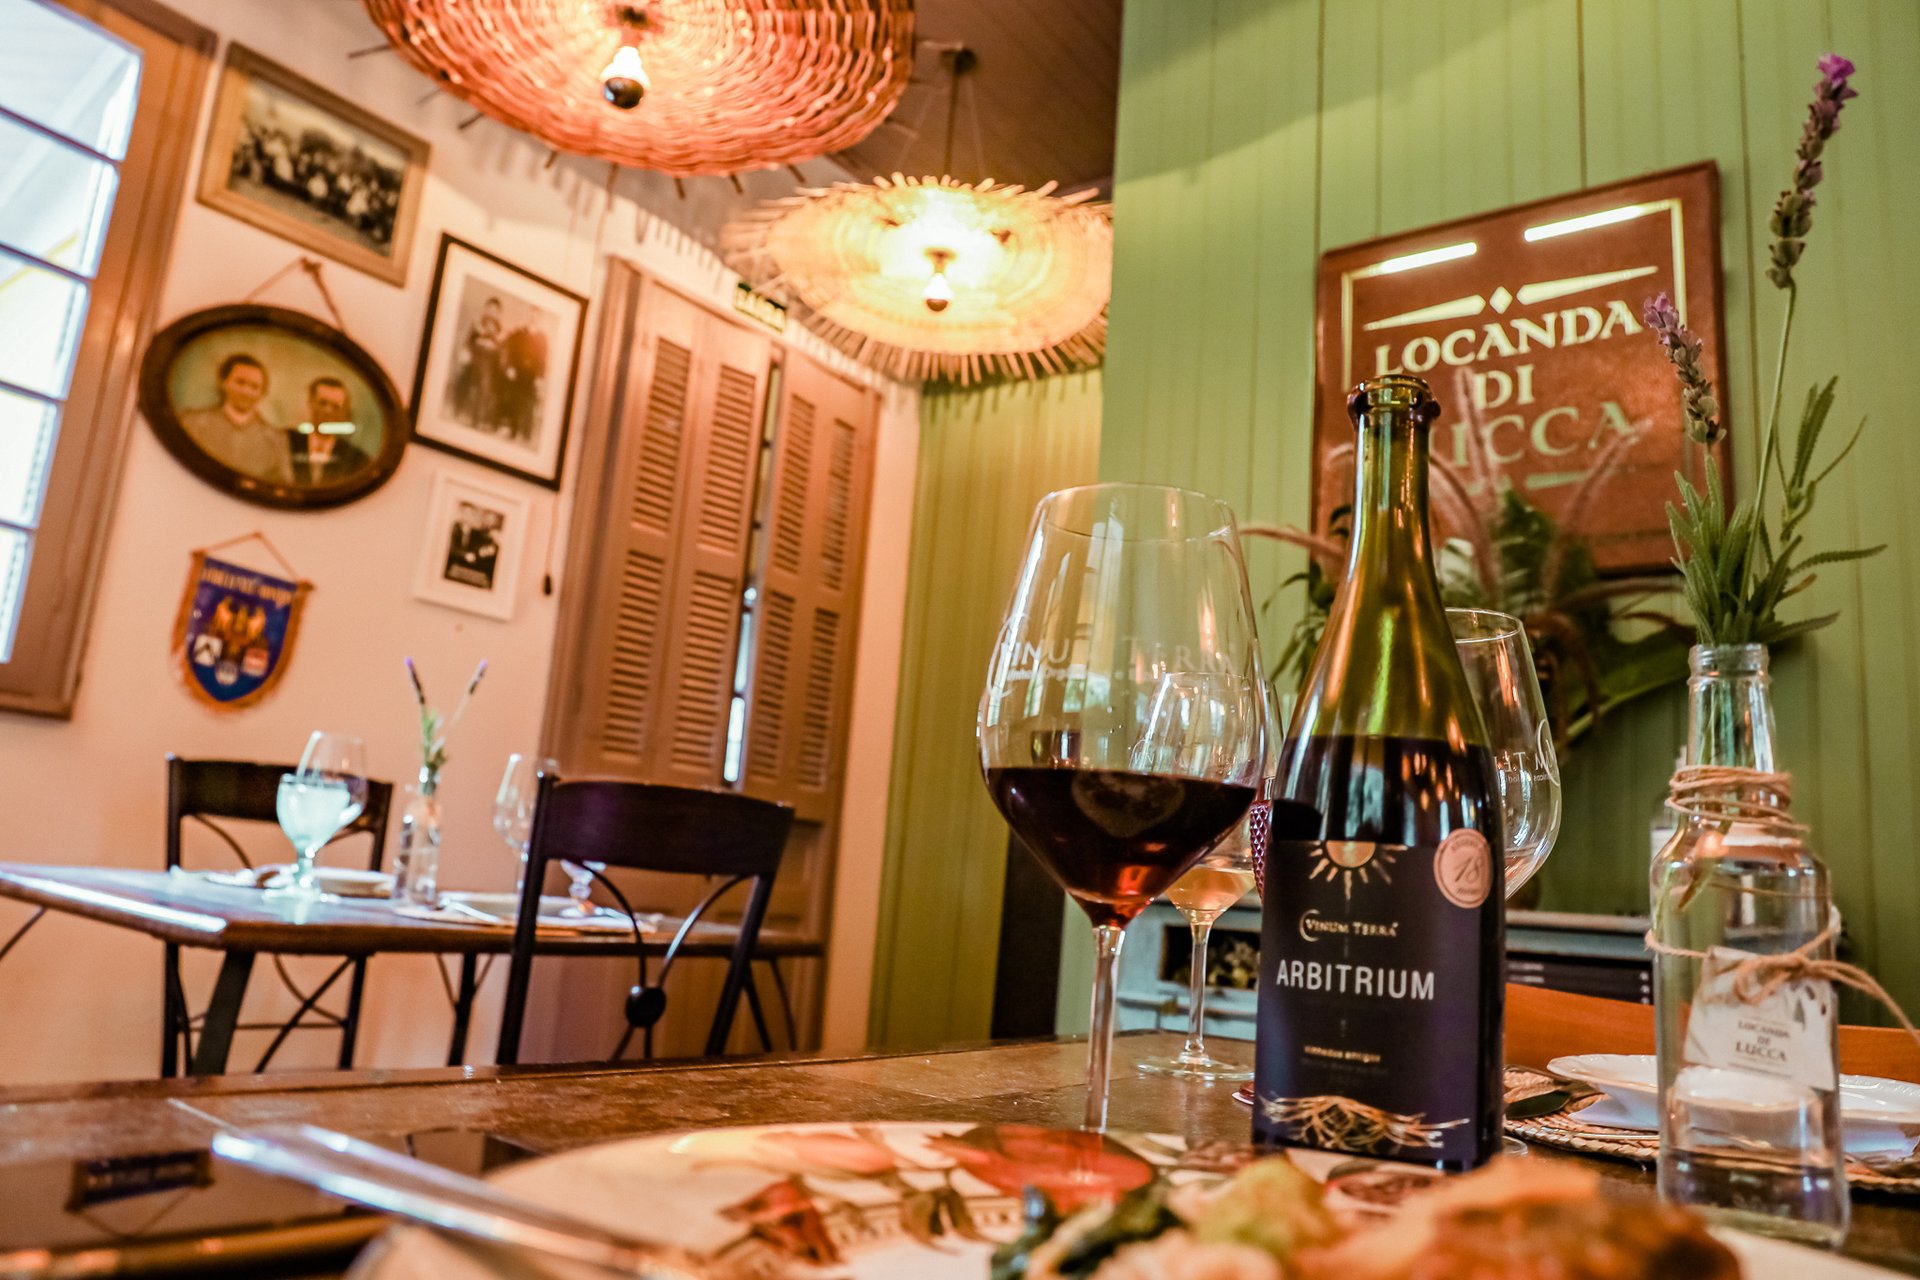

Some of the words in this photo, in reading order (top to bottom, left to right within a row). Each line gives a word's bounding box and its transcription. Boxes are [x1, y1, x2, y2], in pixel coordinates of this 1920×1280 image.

[1375, 301, 1644, 376] LOCANDA
[1473, 364, 1535, 411] DI
[1275, 959, 1436, 1000] ARBITRIUM
[1738, 1020, 1789, 1038] LOCANDA
[1736, 1041, 1786, 1061] LUCCA
